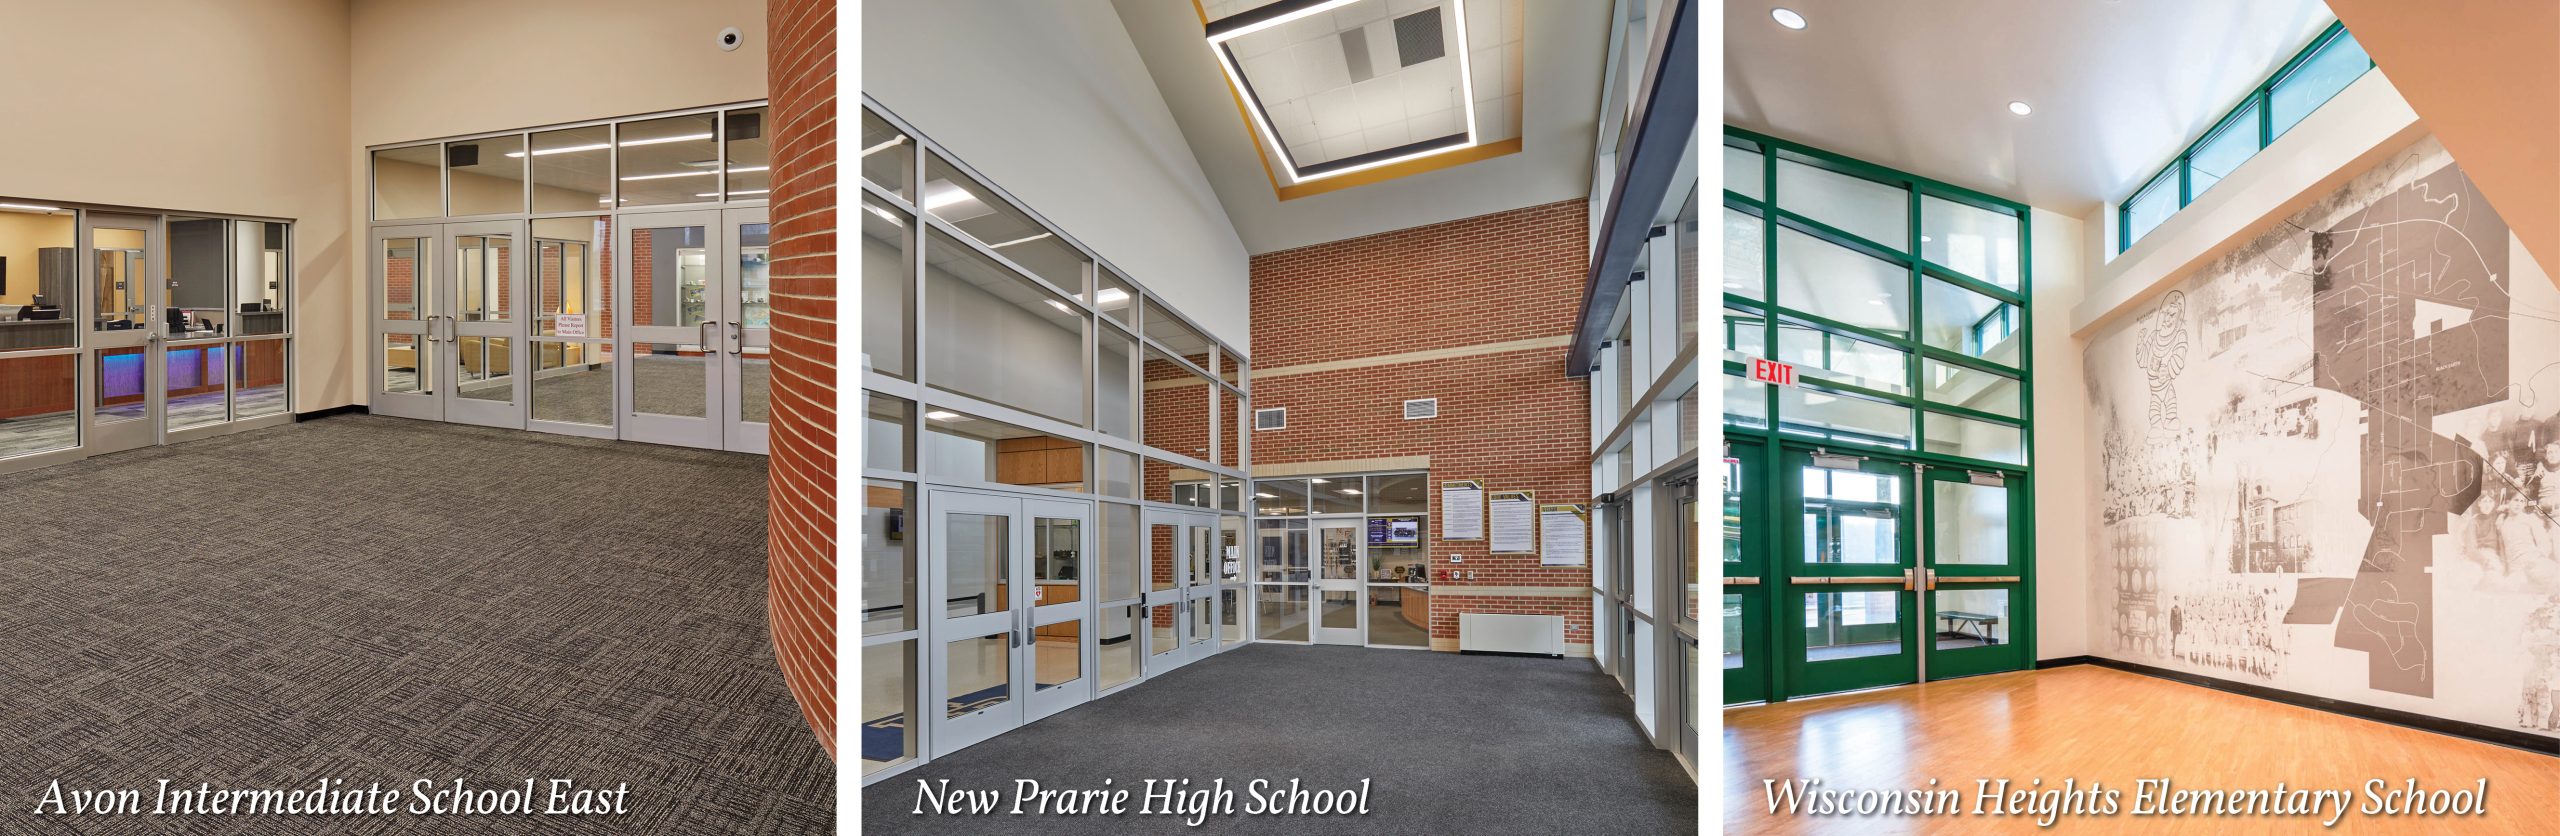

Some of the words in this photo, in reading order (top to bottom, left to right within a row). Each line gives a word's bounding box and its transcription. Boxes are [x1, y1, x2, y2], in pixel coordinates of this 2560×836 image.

[1756, 358, 1793, 385] EXIT
[1225, 545, 1240, 559] MAIN
[1223, 560, 1241, 575] OFFICE
